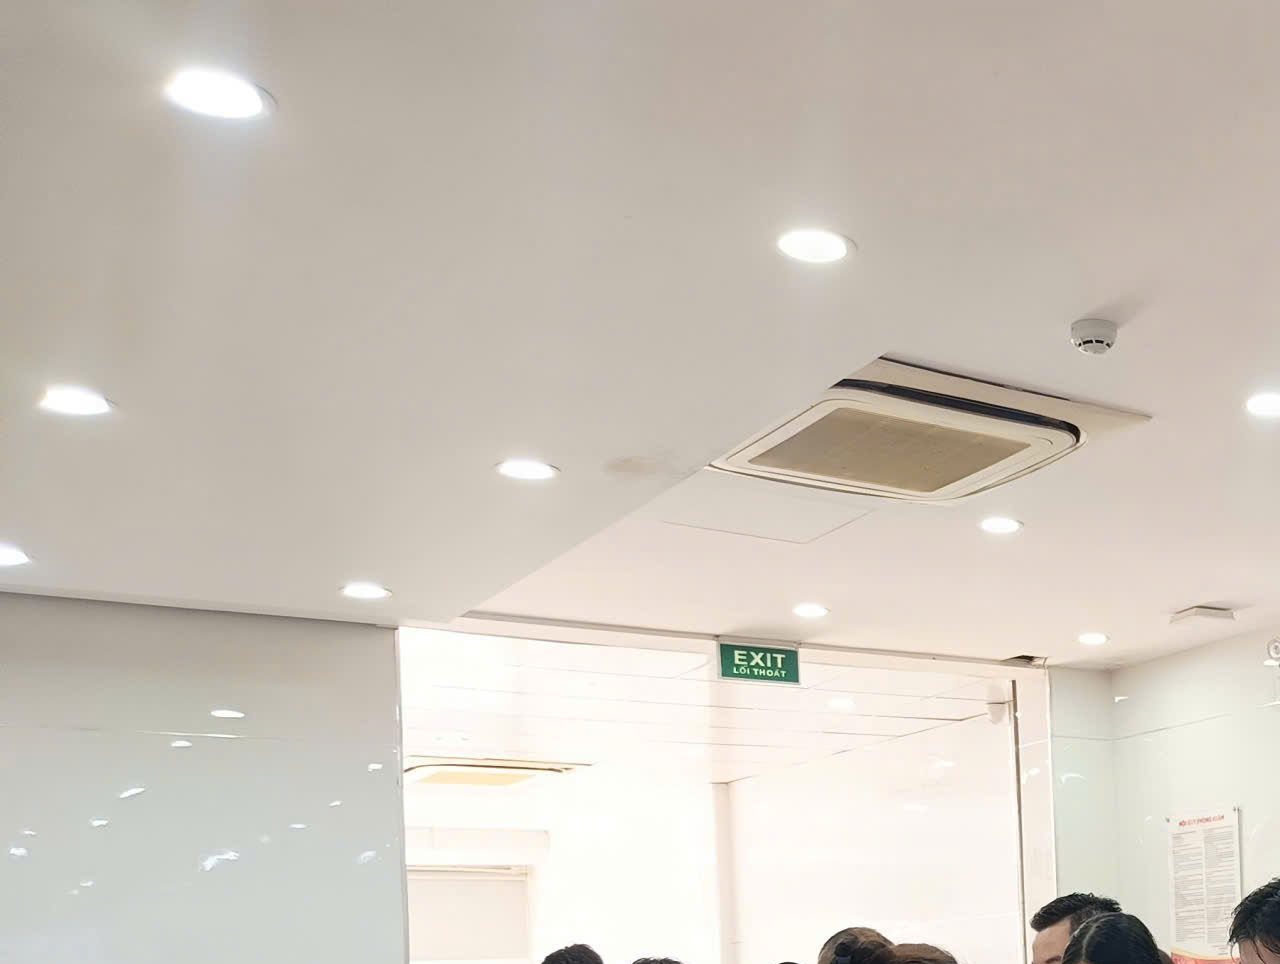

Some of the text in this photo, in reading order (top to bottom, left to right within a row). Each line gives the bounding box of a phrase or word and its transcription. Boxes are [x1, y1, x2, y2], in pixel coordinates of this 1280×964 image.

[734, 650, 786, 668] EXIT
[733, 664, 787, 678] LỐI THOÁT
